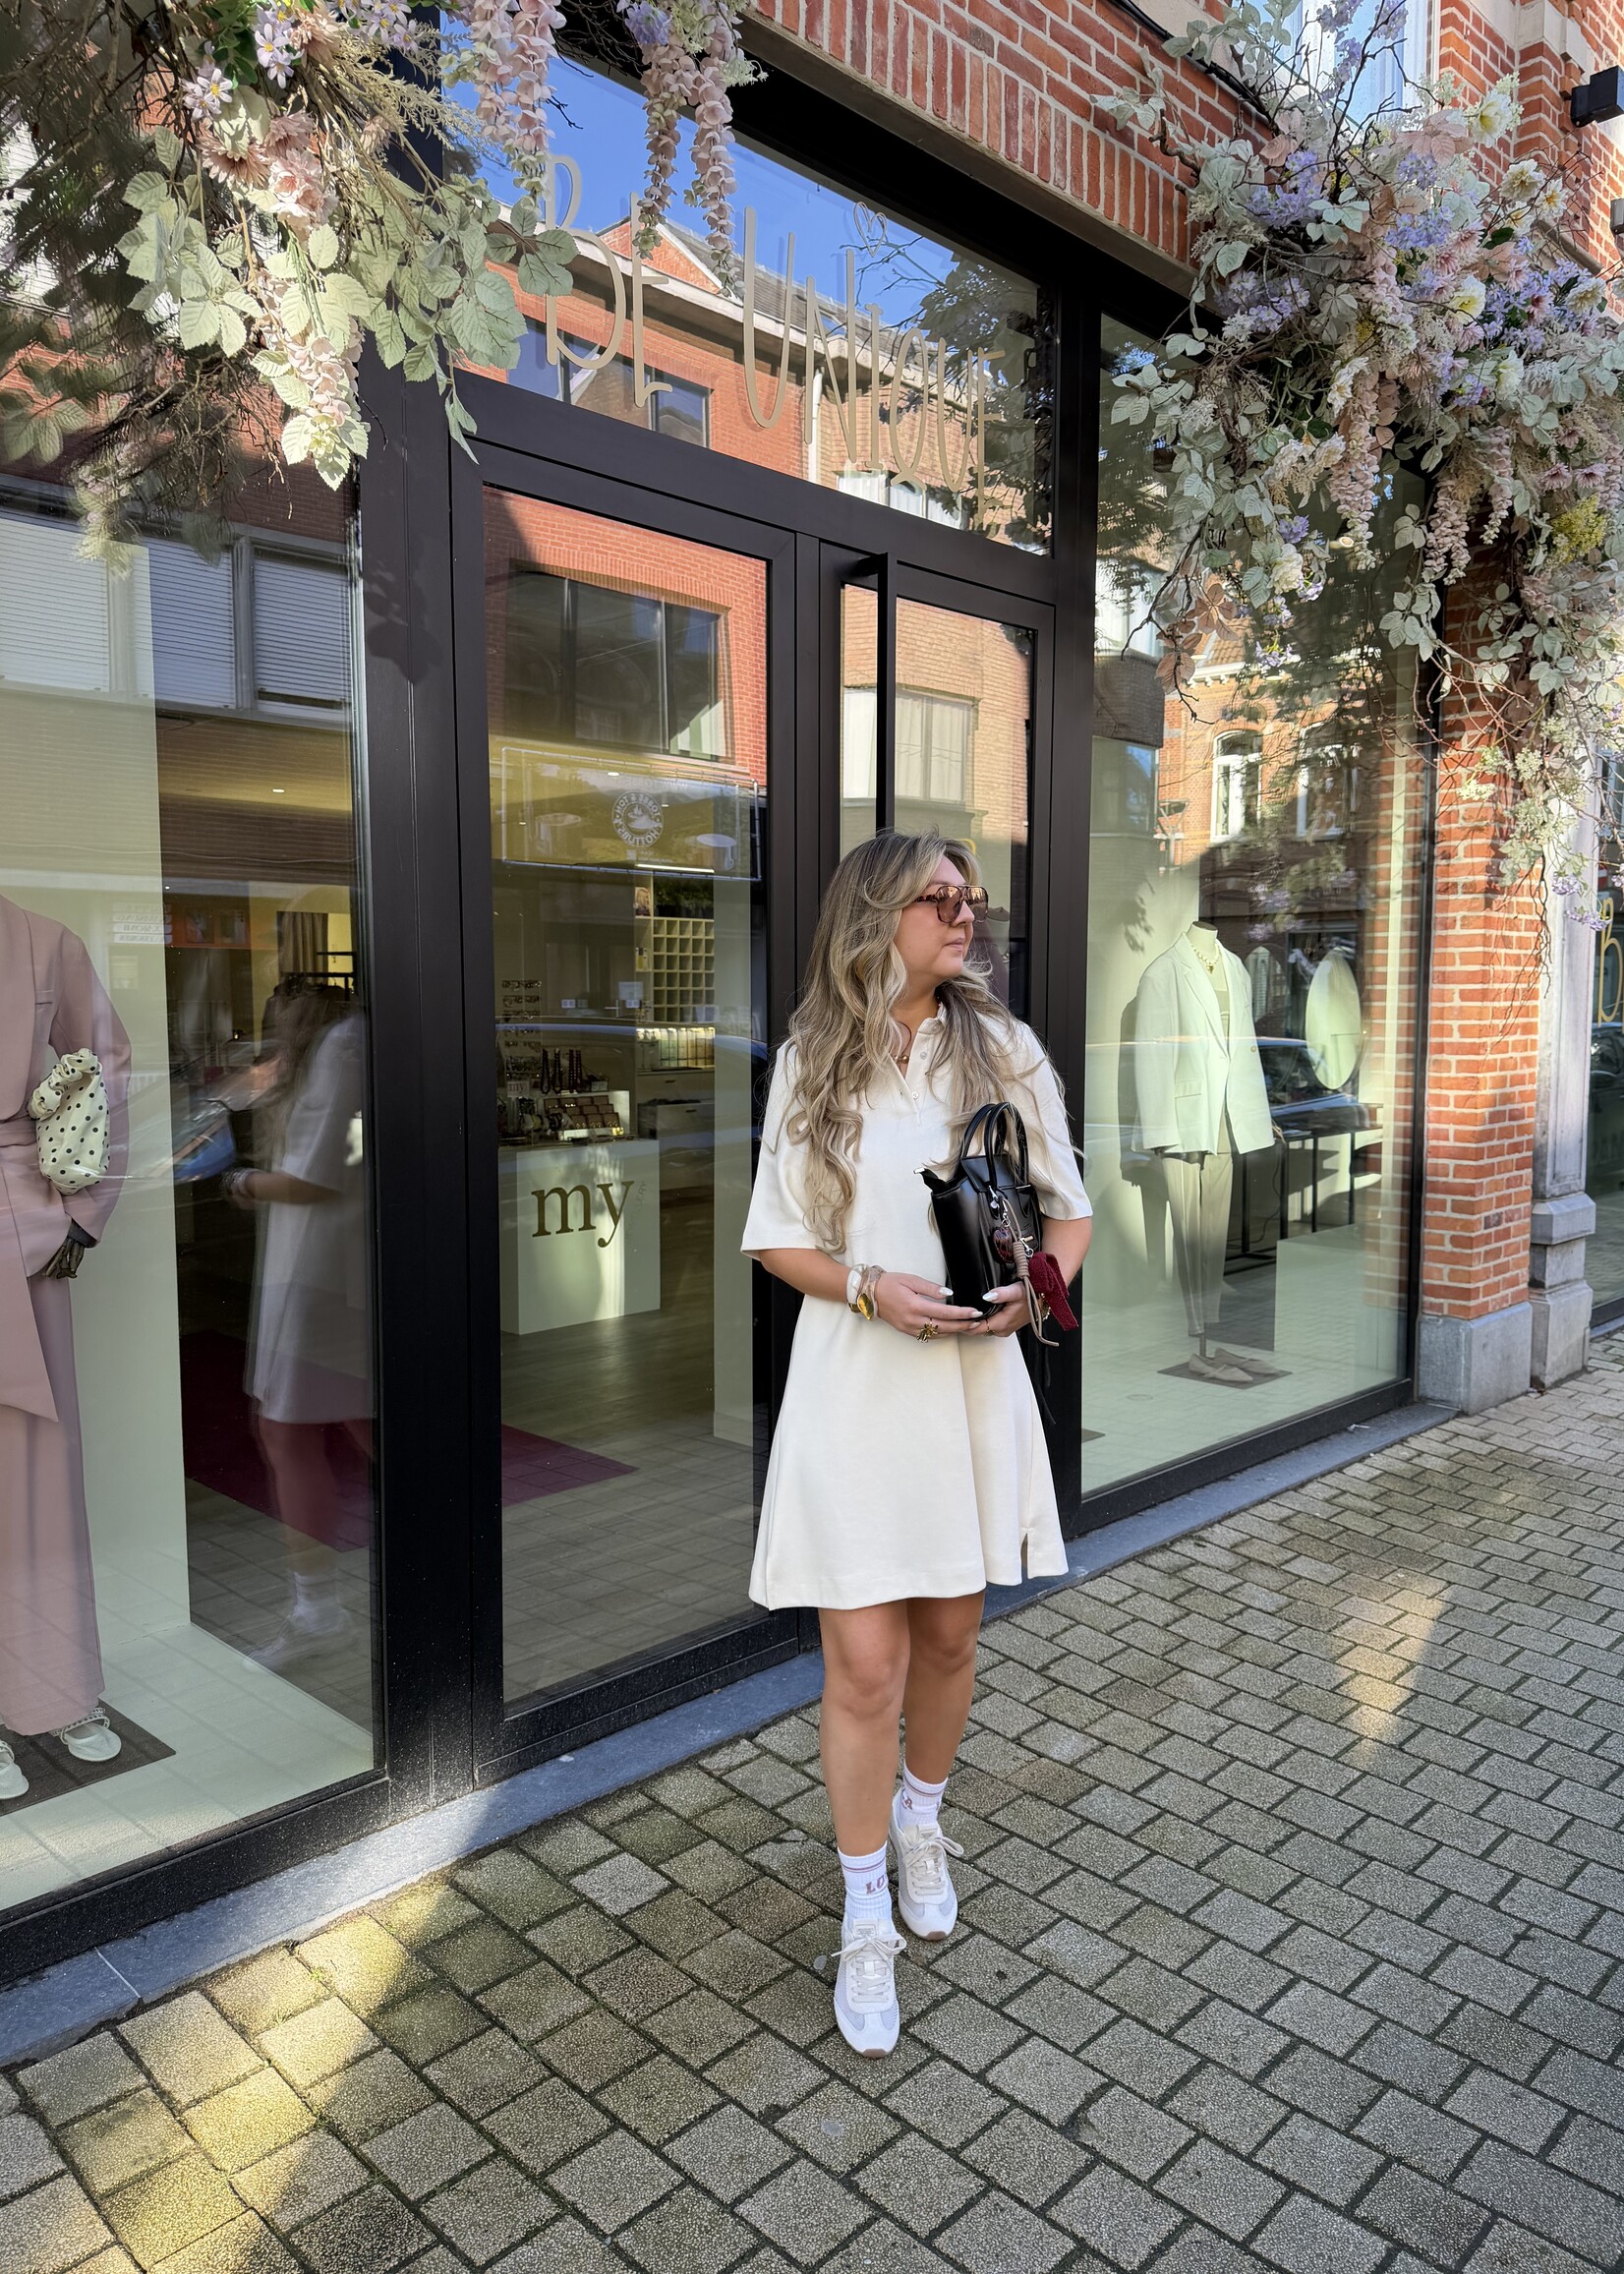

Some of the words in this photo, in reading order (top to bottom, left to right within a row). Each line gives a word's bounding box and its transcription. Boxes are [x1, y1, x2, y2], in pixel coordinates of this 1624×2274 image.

[744, 206, 1008, 527] UNIQUE
[510, 1082, 526, 1094] my
[531, 1180, 635, 1249] my
